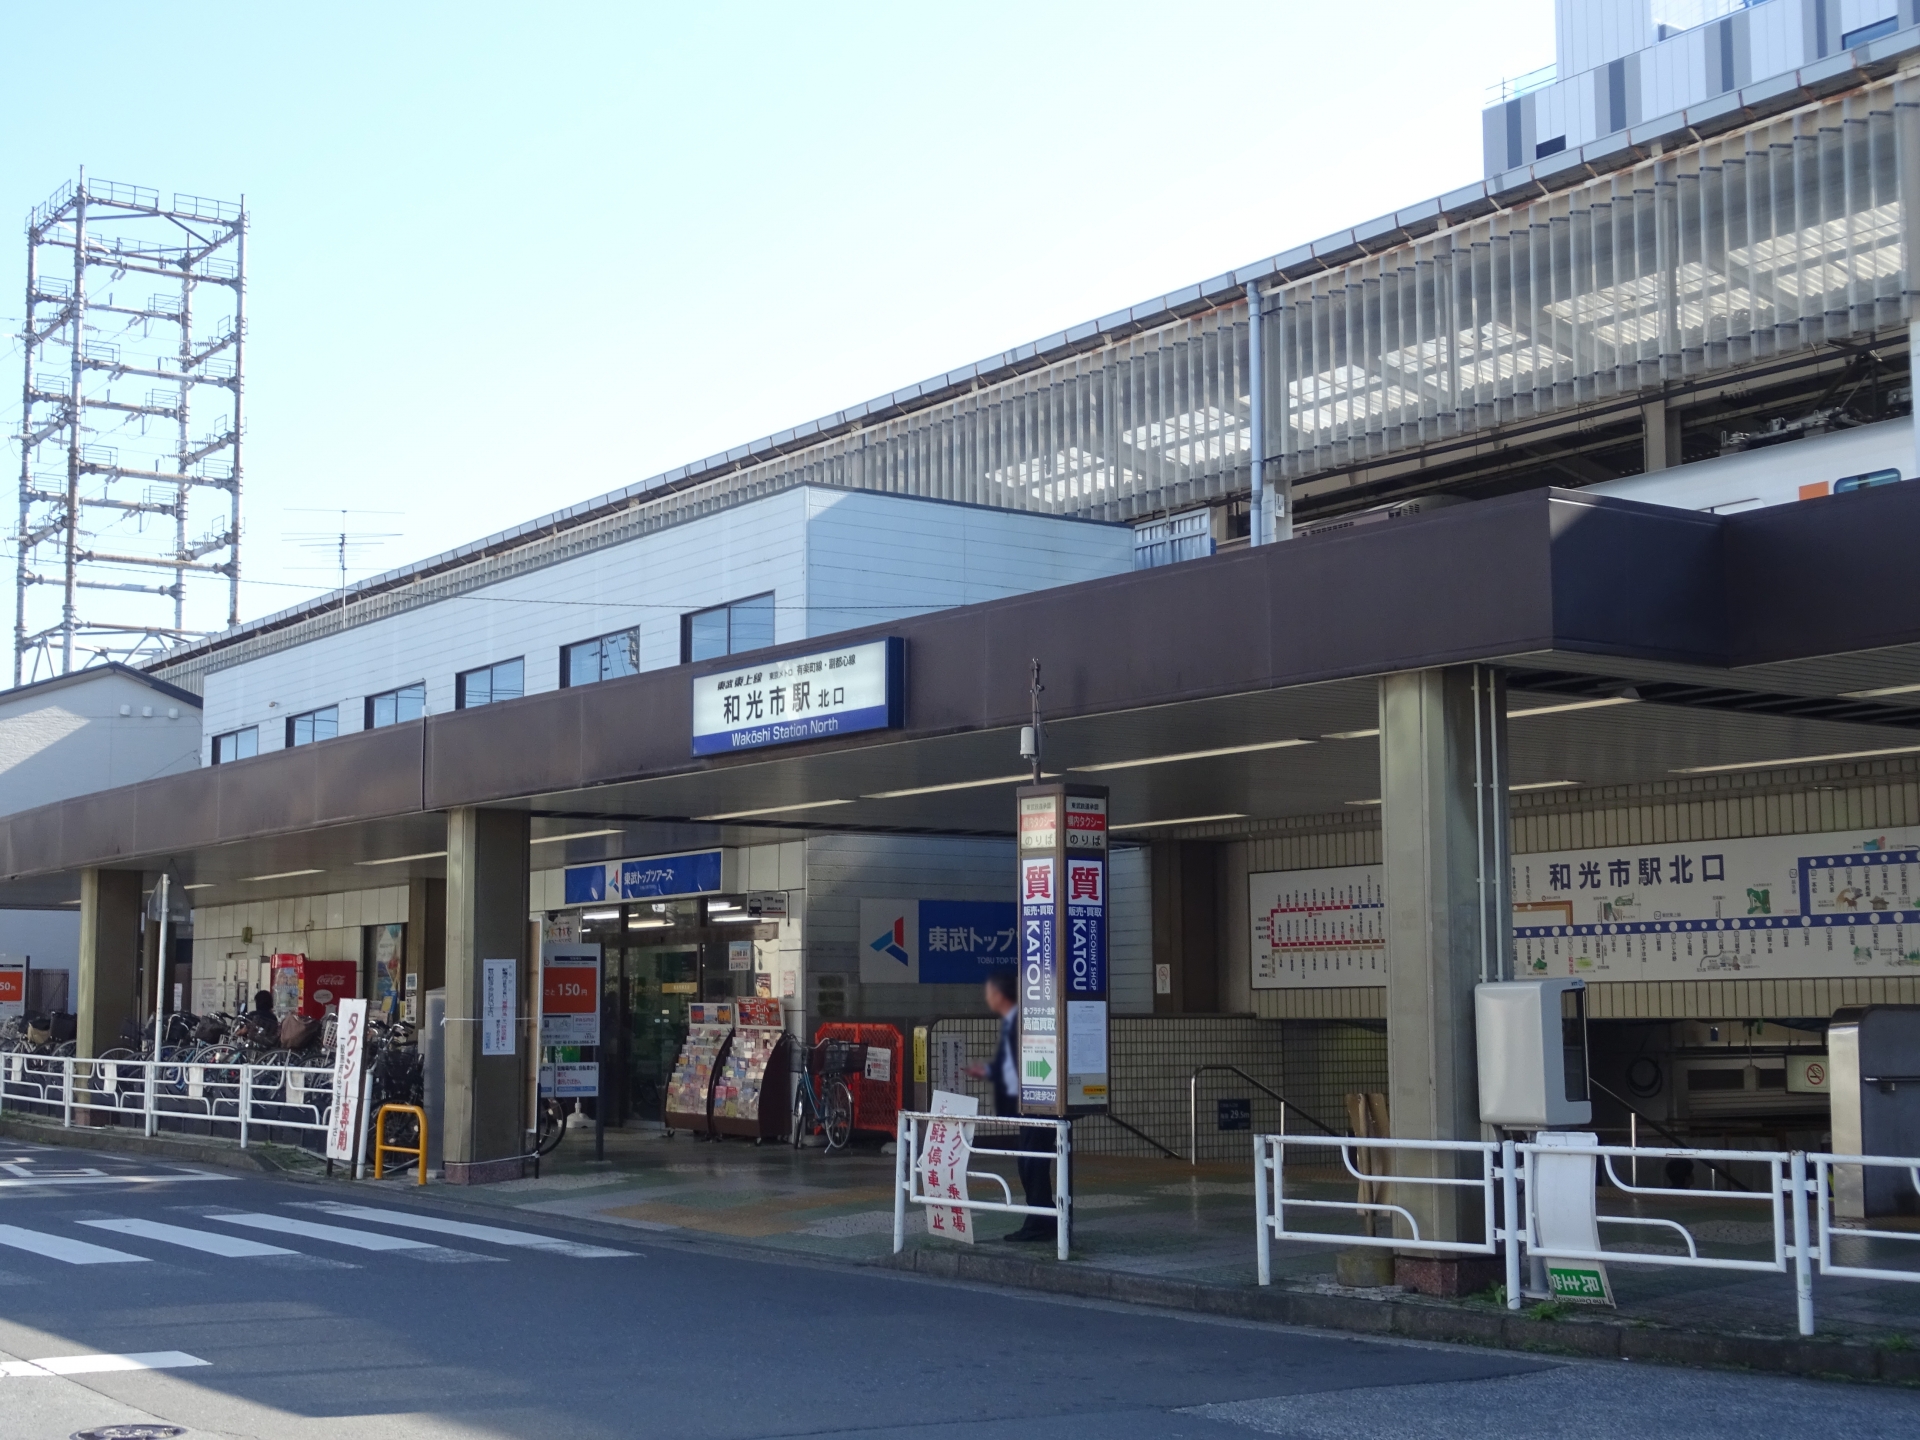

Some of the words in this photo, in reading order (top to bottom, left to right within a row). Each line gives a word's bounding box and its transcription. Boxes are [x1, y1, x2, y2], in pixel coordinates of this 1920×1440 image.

[768, 668, 794, 680] 東京メトロ
[723, 680, 811, 725] 和光市駅
[817, 686, 845, 708] 北口
[731, 728, 771, 747] Wakōshi
[772, 721, 808, 741] Station
[809, 717, 839, 735] North
[1067, 815, 1102, 827] 構内タクシー
[1025, 833, 1053, 846] のりば
[1069, 834, 1101, 847] のりば
[624, 868, 675, 885] 東武トップツアーズ
[1549, 854, 1725, 891] 和光市駅北口
[1025, 865, 1051, 899] 質
[1071, 866, 1100, 901] 質
[1023, 905, 1054, 916] 販売・買取
[1068, 906, 1102, 917] 販売・買取
[929, 926, 1018, 952] 東武トップ
[976, 957, 995, 965] TOBU
[996, 957, 1009, 965] TOP
[1026, 920, 1041, 1001] KATOU
[1072, 919, 1087, 991] KATOU
[317, 974, 346, 986] Coca-Cola
[1023, 1017, 1056, 1031] 高価買取
[1022, 1089, 1056, 1101] 北口徒歩2分
